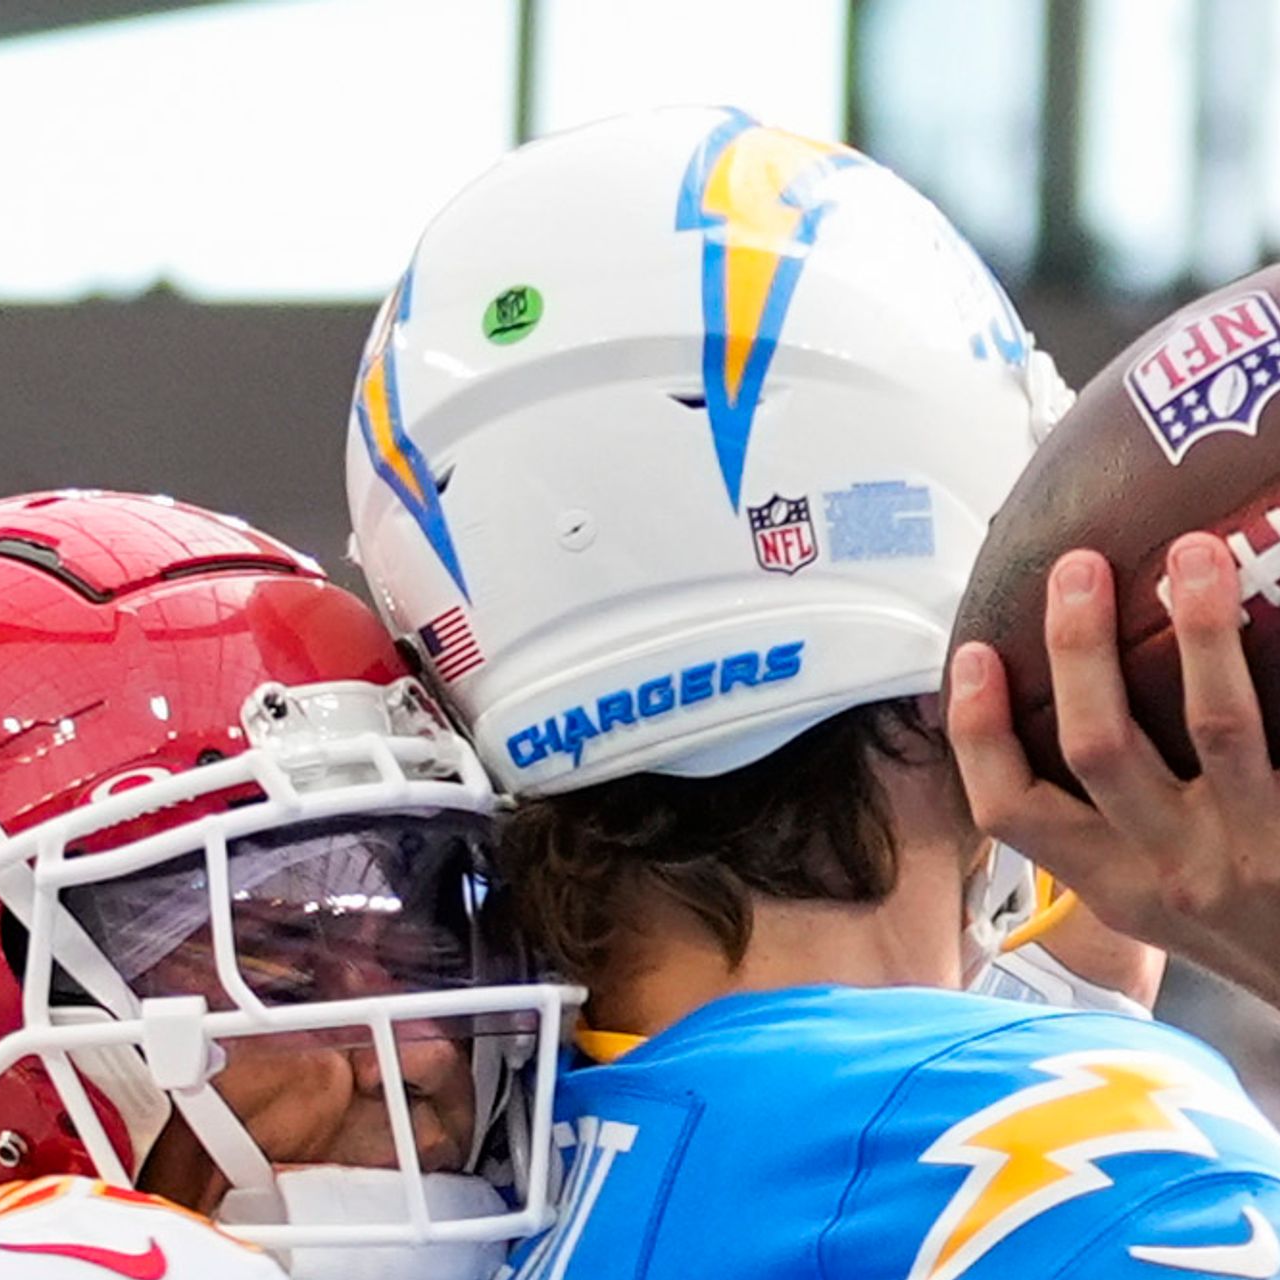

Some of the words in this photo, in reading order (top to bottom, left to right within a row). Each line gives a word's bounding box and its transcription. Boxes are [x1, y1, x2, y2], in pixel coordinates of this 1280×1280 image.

[1140, 302, 1268, 391] NFL
[759, 526, 813, 566] NFL
[506, 640, 806, 769] CHARGERS
